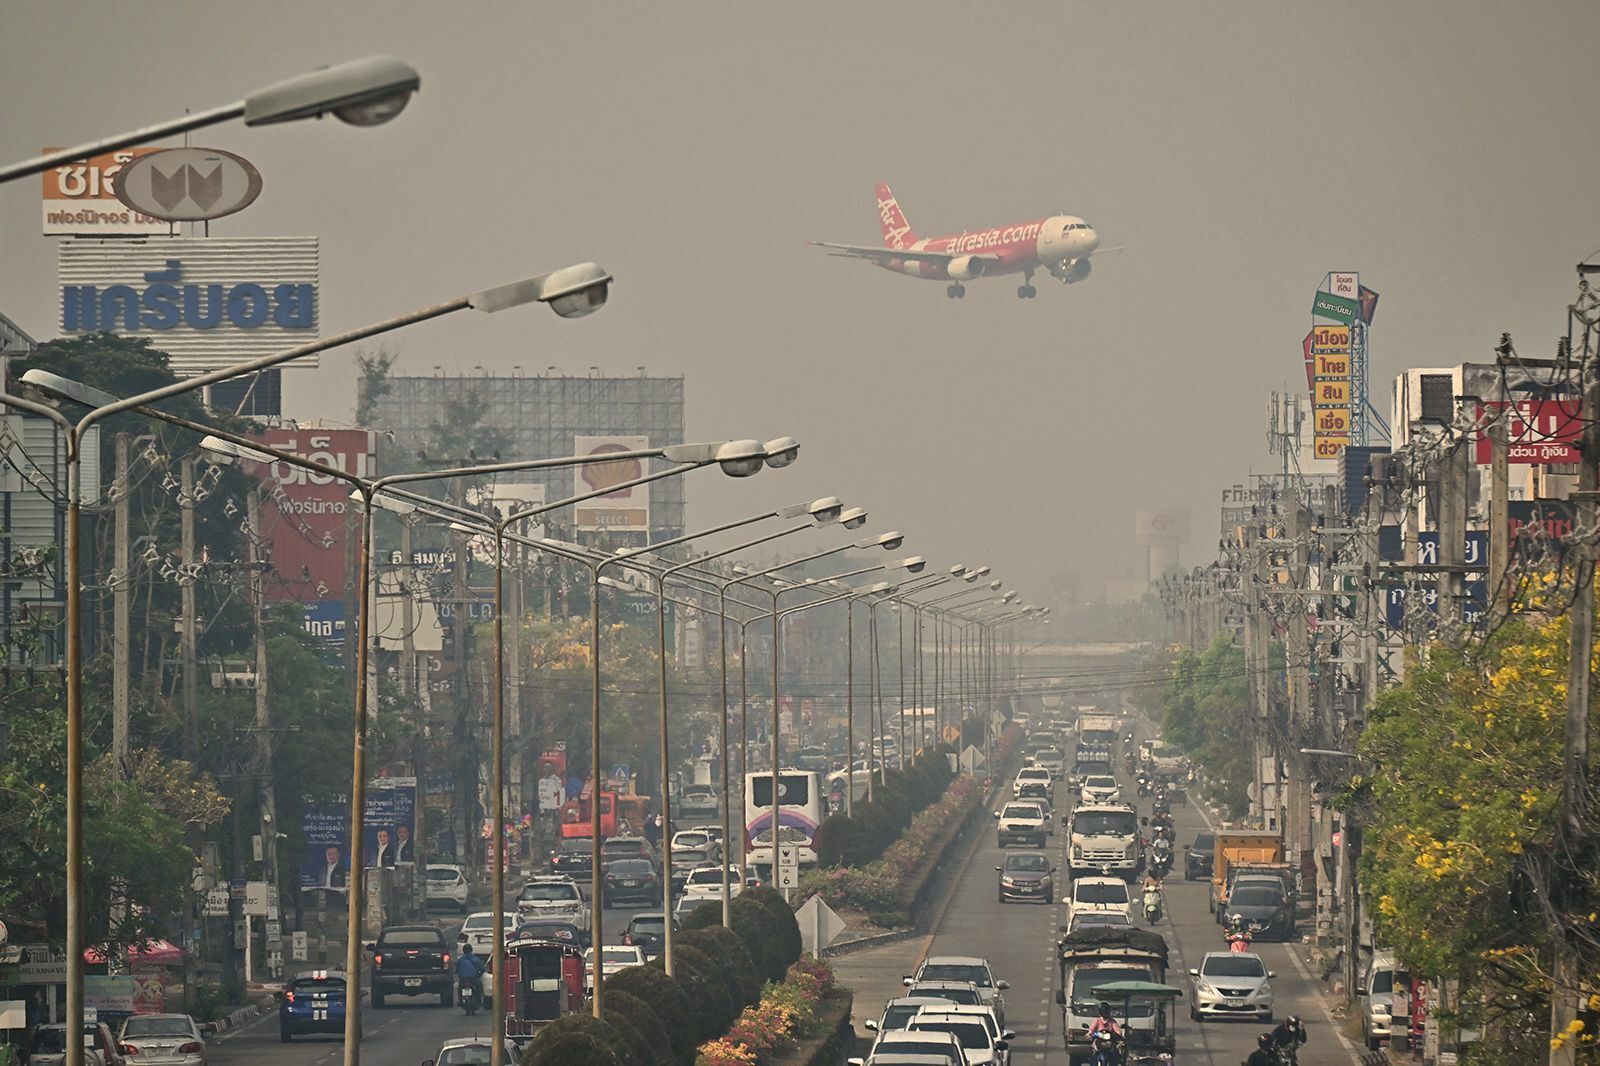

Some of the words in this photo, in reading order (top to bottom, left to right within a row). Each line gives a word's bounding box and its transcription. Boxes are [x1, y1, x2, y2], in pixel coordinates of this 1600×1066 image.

[945, 222, 1040, 254] airasia.com
[1315, 330, 1349, 345] เมือง
[1319, 356, 1346, 373] ไทย
[1319, 411, 1345, 430] เชื่อ
[783, 875, 790, 885] 6
